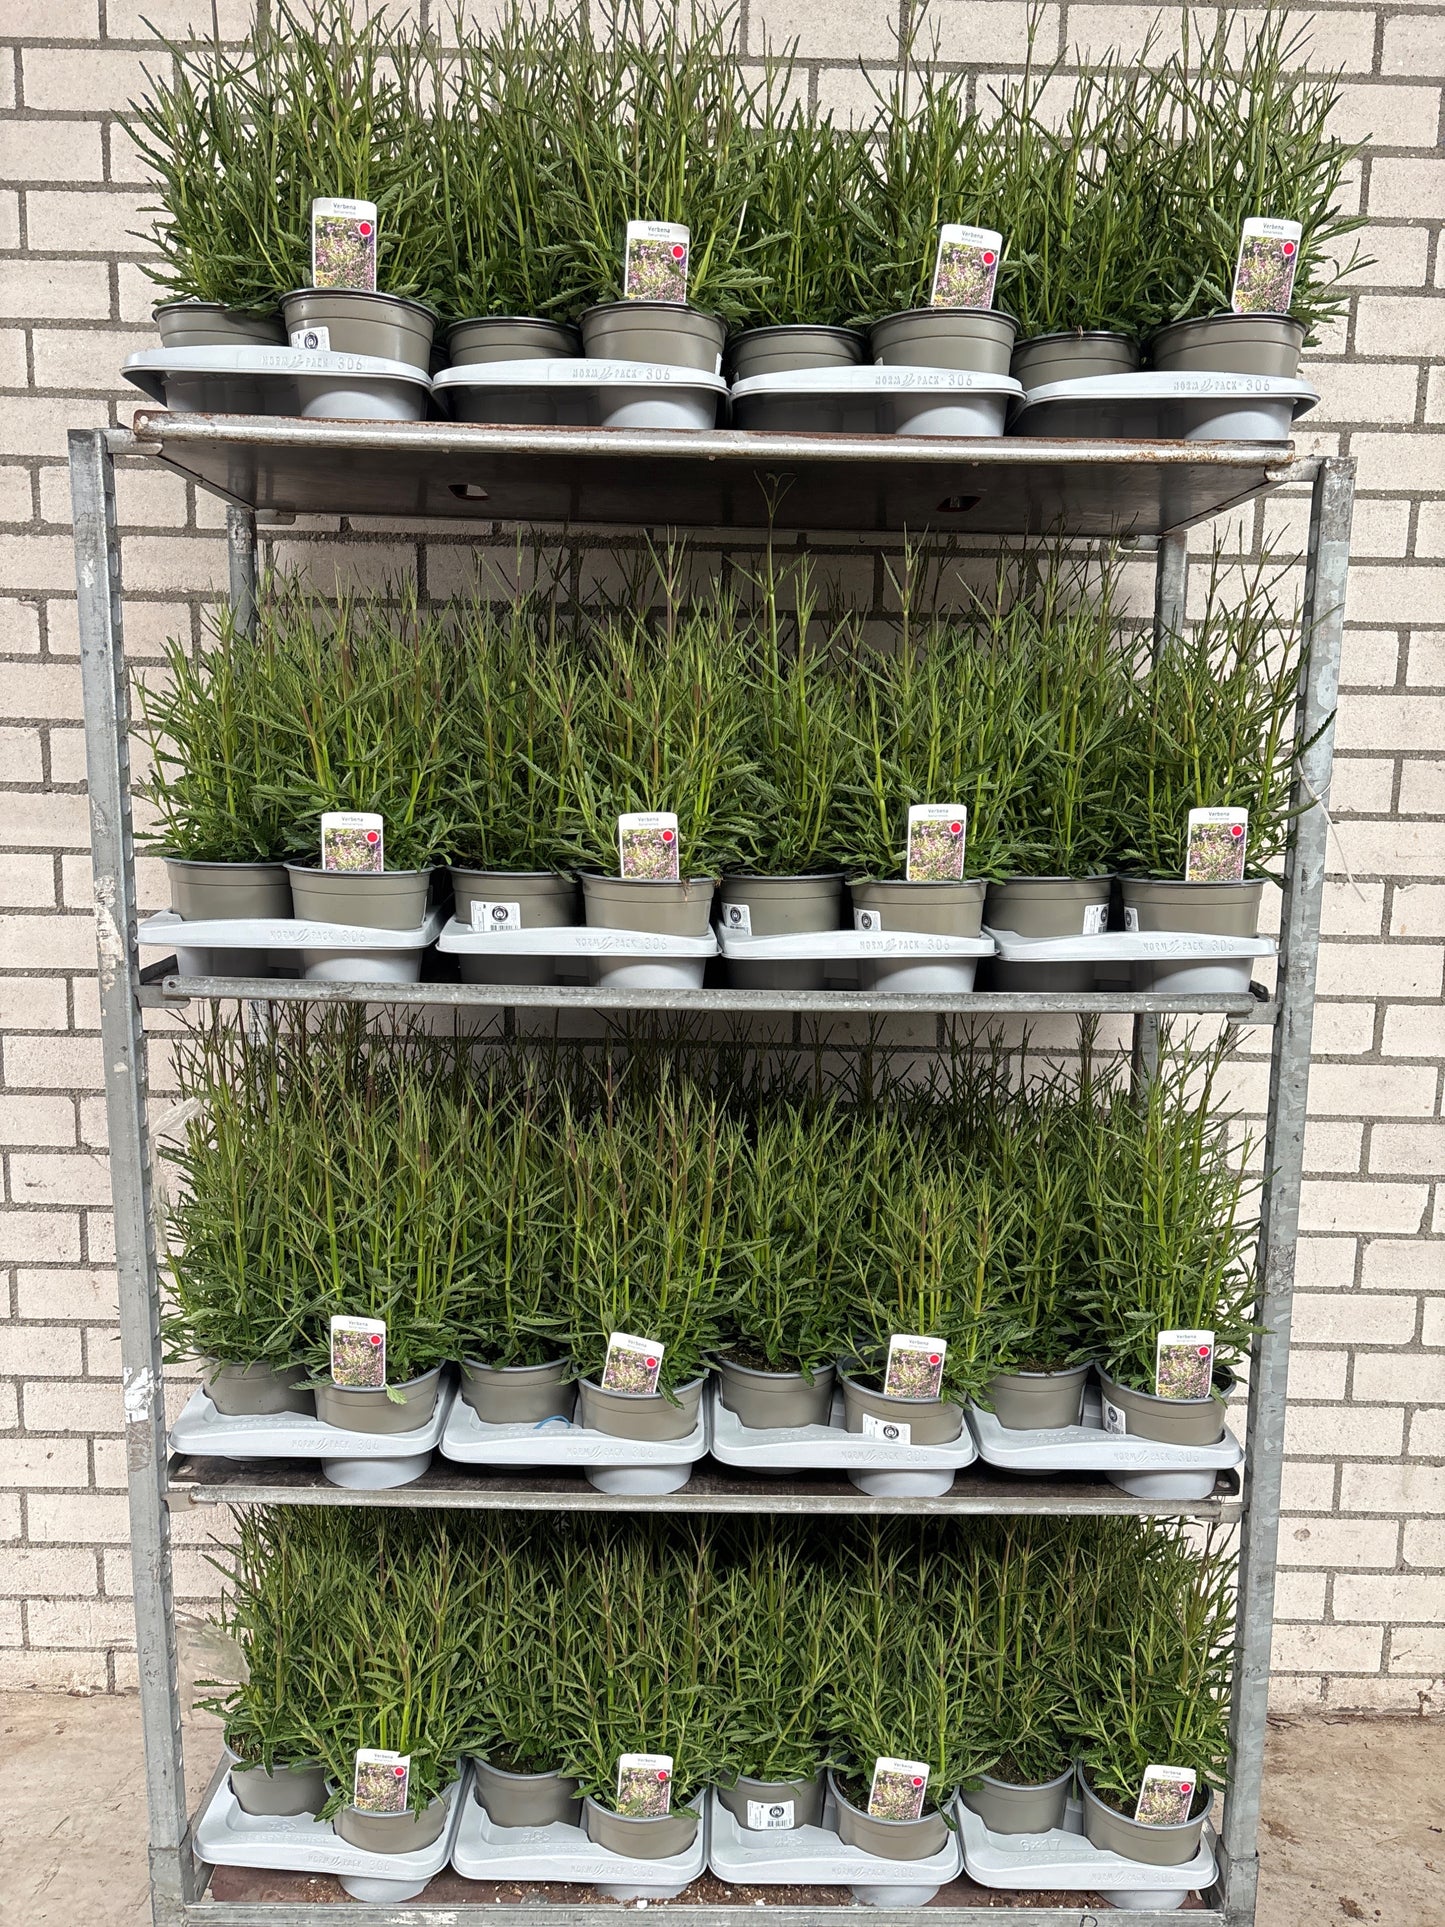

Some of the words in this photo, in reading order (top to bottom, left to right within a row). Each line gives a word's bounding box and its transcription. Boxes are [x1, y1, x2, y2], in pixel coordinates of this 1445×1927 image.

[333, 202, 356, 210] Verbena
[648, 226, 670, 234] Verbena
[1263, 223, 1284, 231] Verbena
[962, 230, 984, 239] Verbena
[262, 355, 288, 366] NORM
[338, 356, 362, 370] 306
[572, 368, 598, 378] NORM
[646, 368, 670, 380] 306
[875, 375, 900, 385] NORM
[948, 374, 972, 386] 306
[1174, 381, 1198, 391] NORM
[1246, 379, 1270, 391] 306
[342, 930, 366, 943] 306
[645, 937, 667, 950] 306
[928, 938, 950, 951] 306
[1212, 940, 1234, 952] 306
